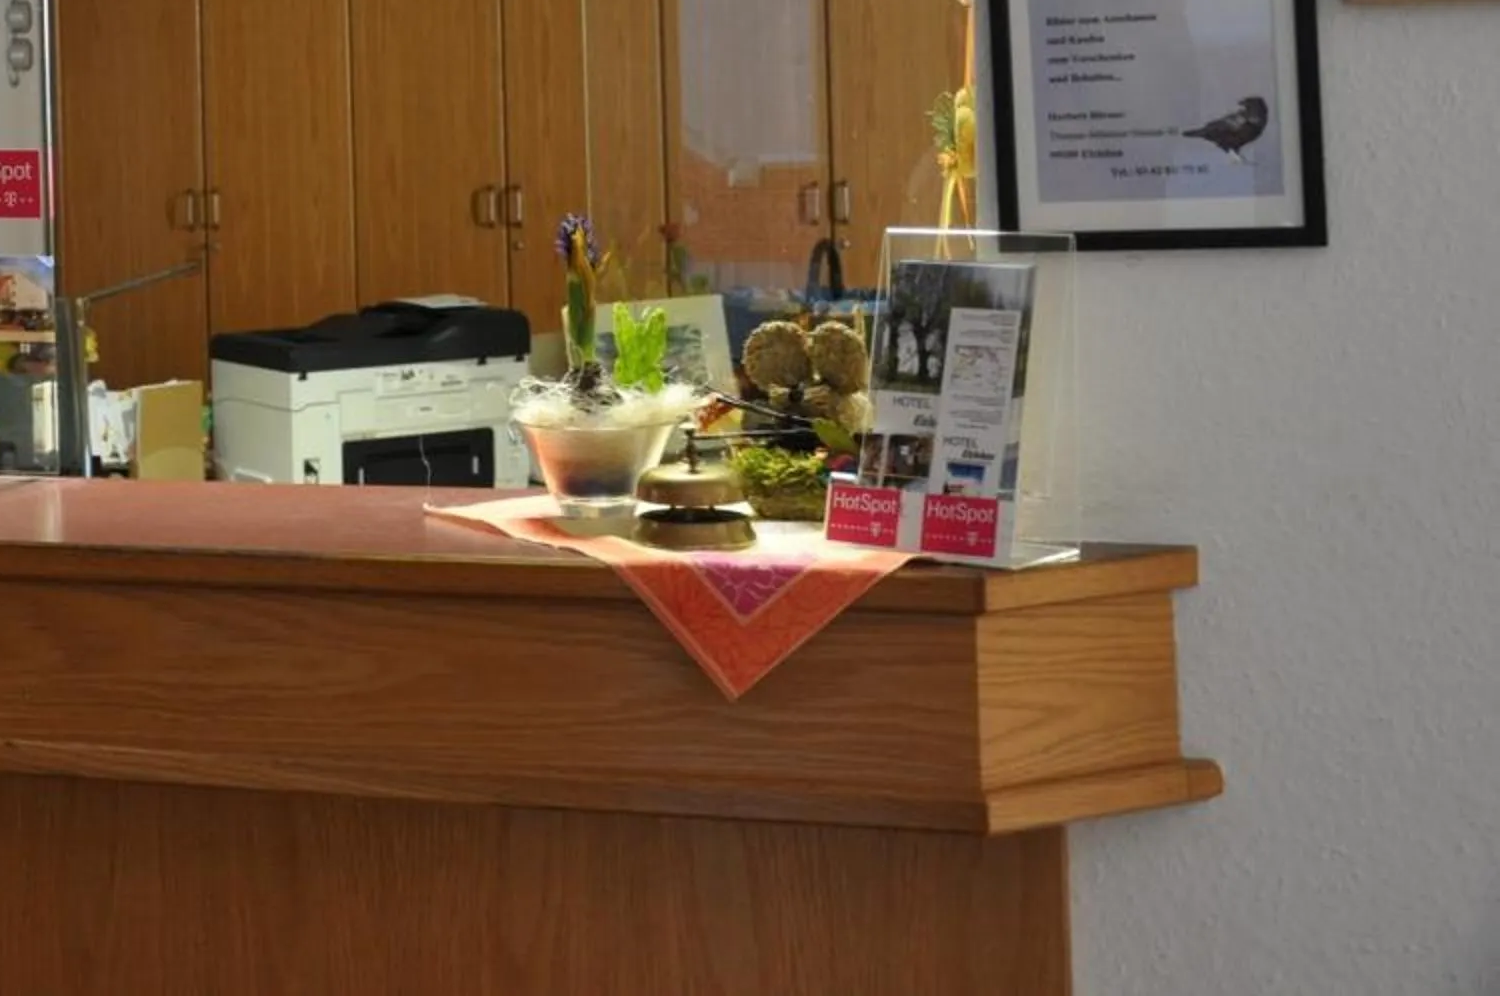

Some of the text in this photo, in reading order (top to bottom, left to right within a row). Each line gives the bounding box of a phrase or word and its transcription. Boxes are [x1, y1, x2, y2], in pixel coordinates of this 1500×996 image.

[892, 394, 933, 410] HOTEL
[942, 435, 979, 450] HOTEL
[833, 490, 898, 516] HotSpot
[926, 499, 996, 526] HotSpot
